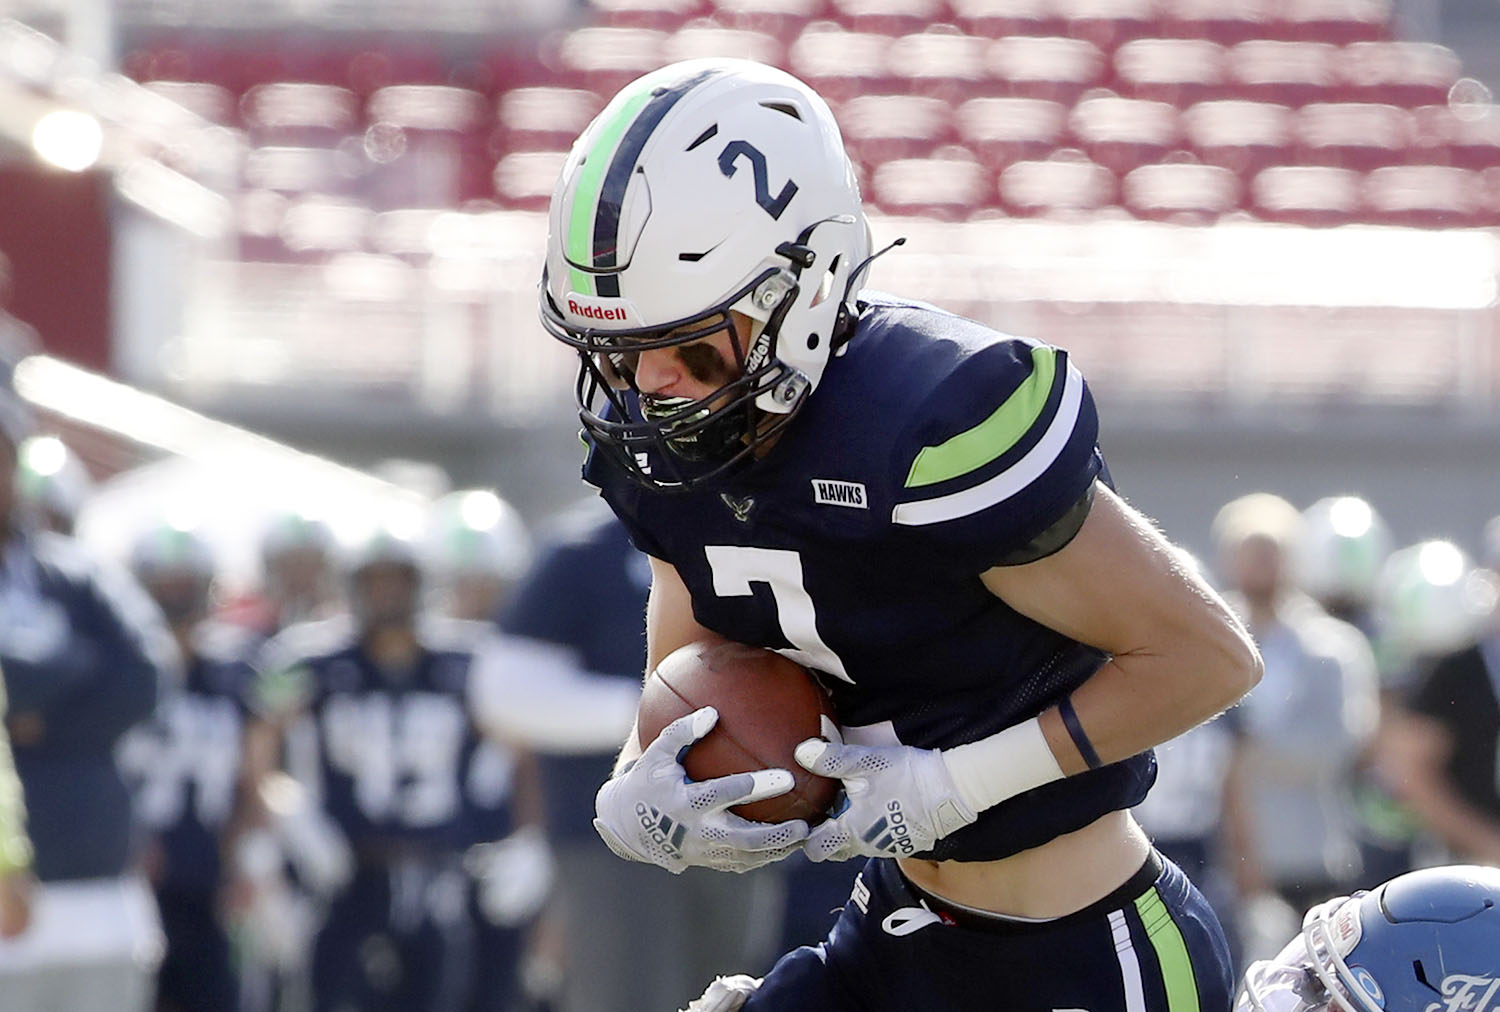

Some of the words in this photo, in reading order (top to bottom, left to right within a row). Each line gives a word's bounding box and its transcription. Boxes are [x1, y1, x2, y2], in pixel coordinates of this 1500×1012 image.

[717, 140, 799, 222] 2
[567, 300, 628, 321] Riddell
[817, 482, 863, 506] HAWKS
[634, 801, 684, 860] adidas
[887, 799, 916, 855] adidas
